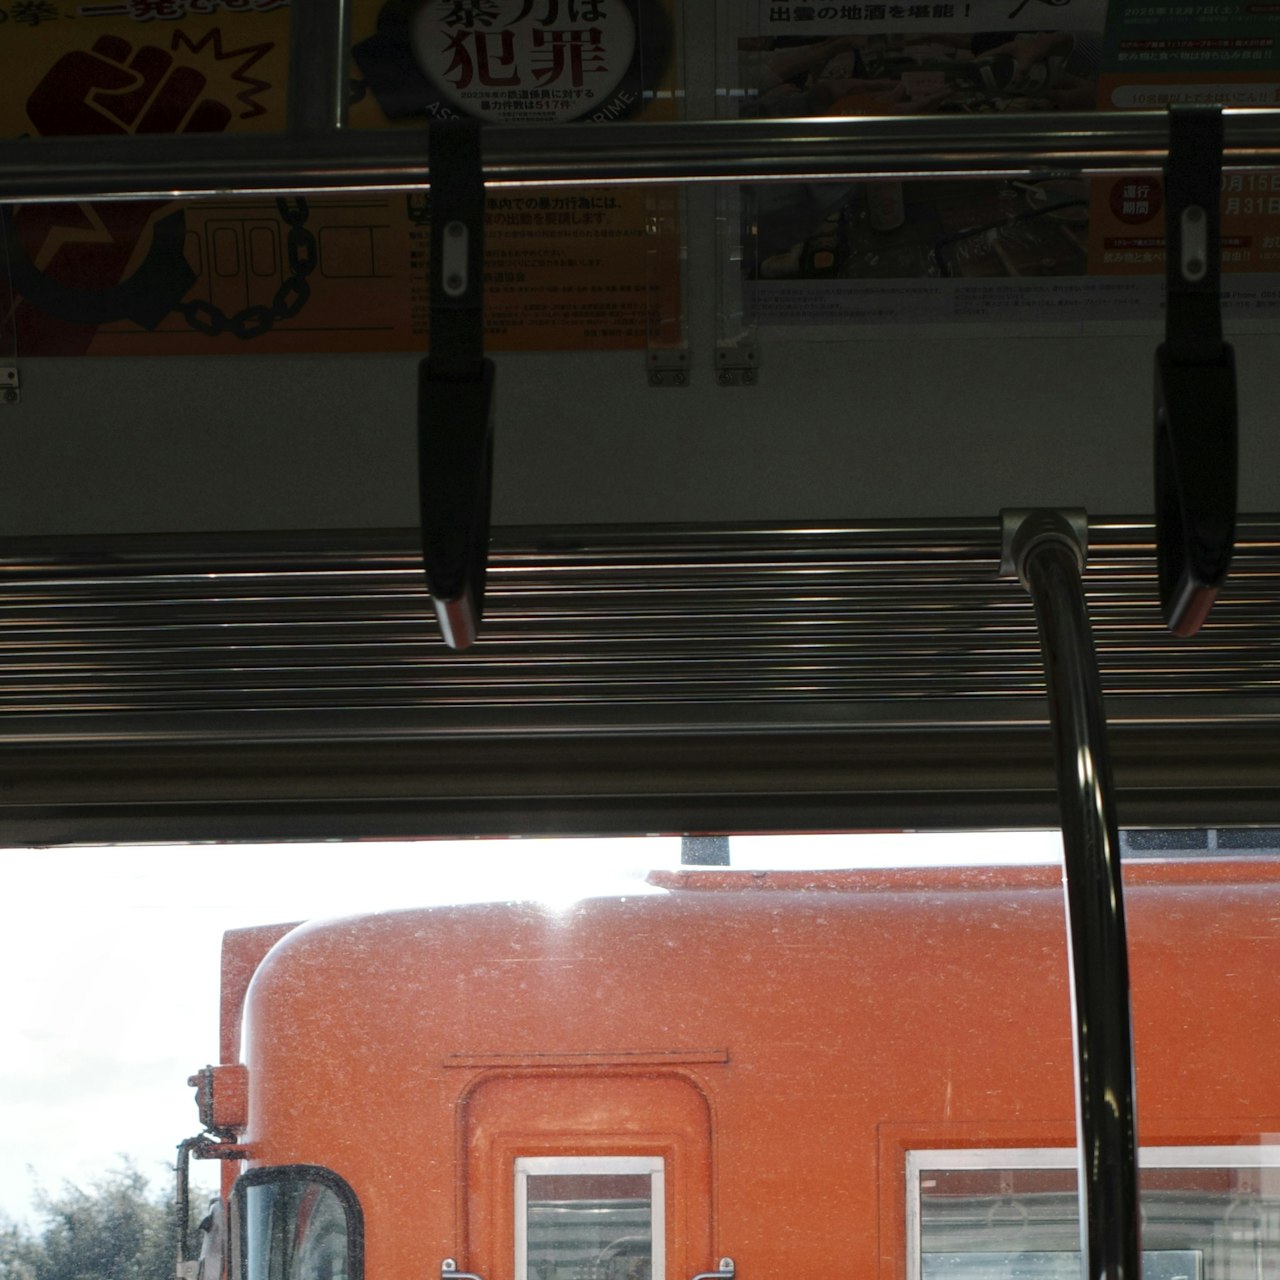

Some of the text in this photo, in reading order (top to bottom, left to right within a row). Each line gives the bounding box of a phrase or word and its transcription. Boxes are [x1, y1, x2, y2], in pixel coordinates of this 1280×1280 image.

[440, 28, 609, 89] 犯罪
[1123, 185, 1151, 198] 運行
[1122, 201, 1150, 215] 期間
